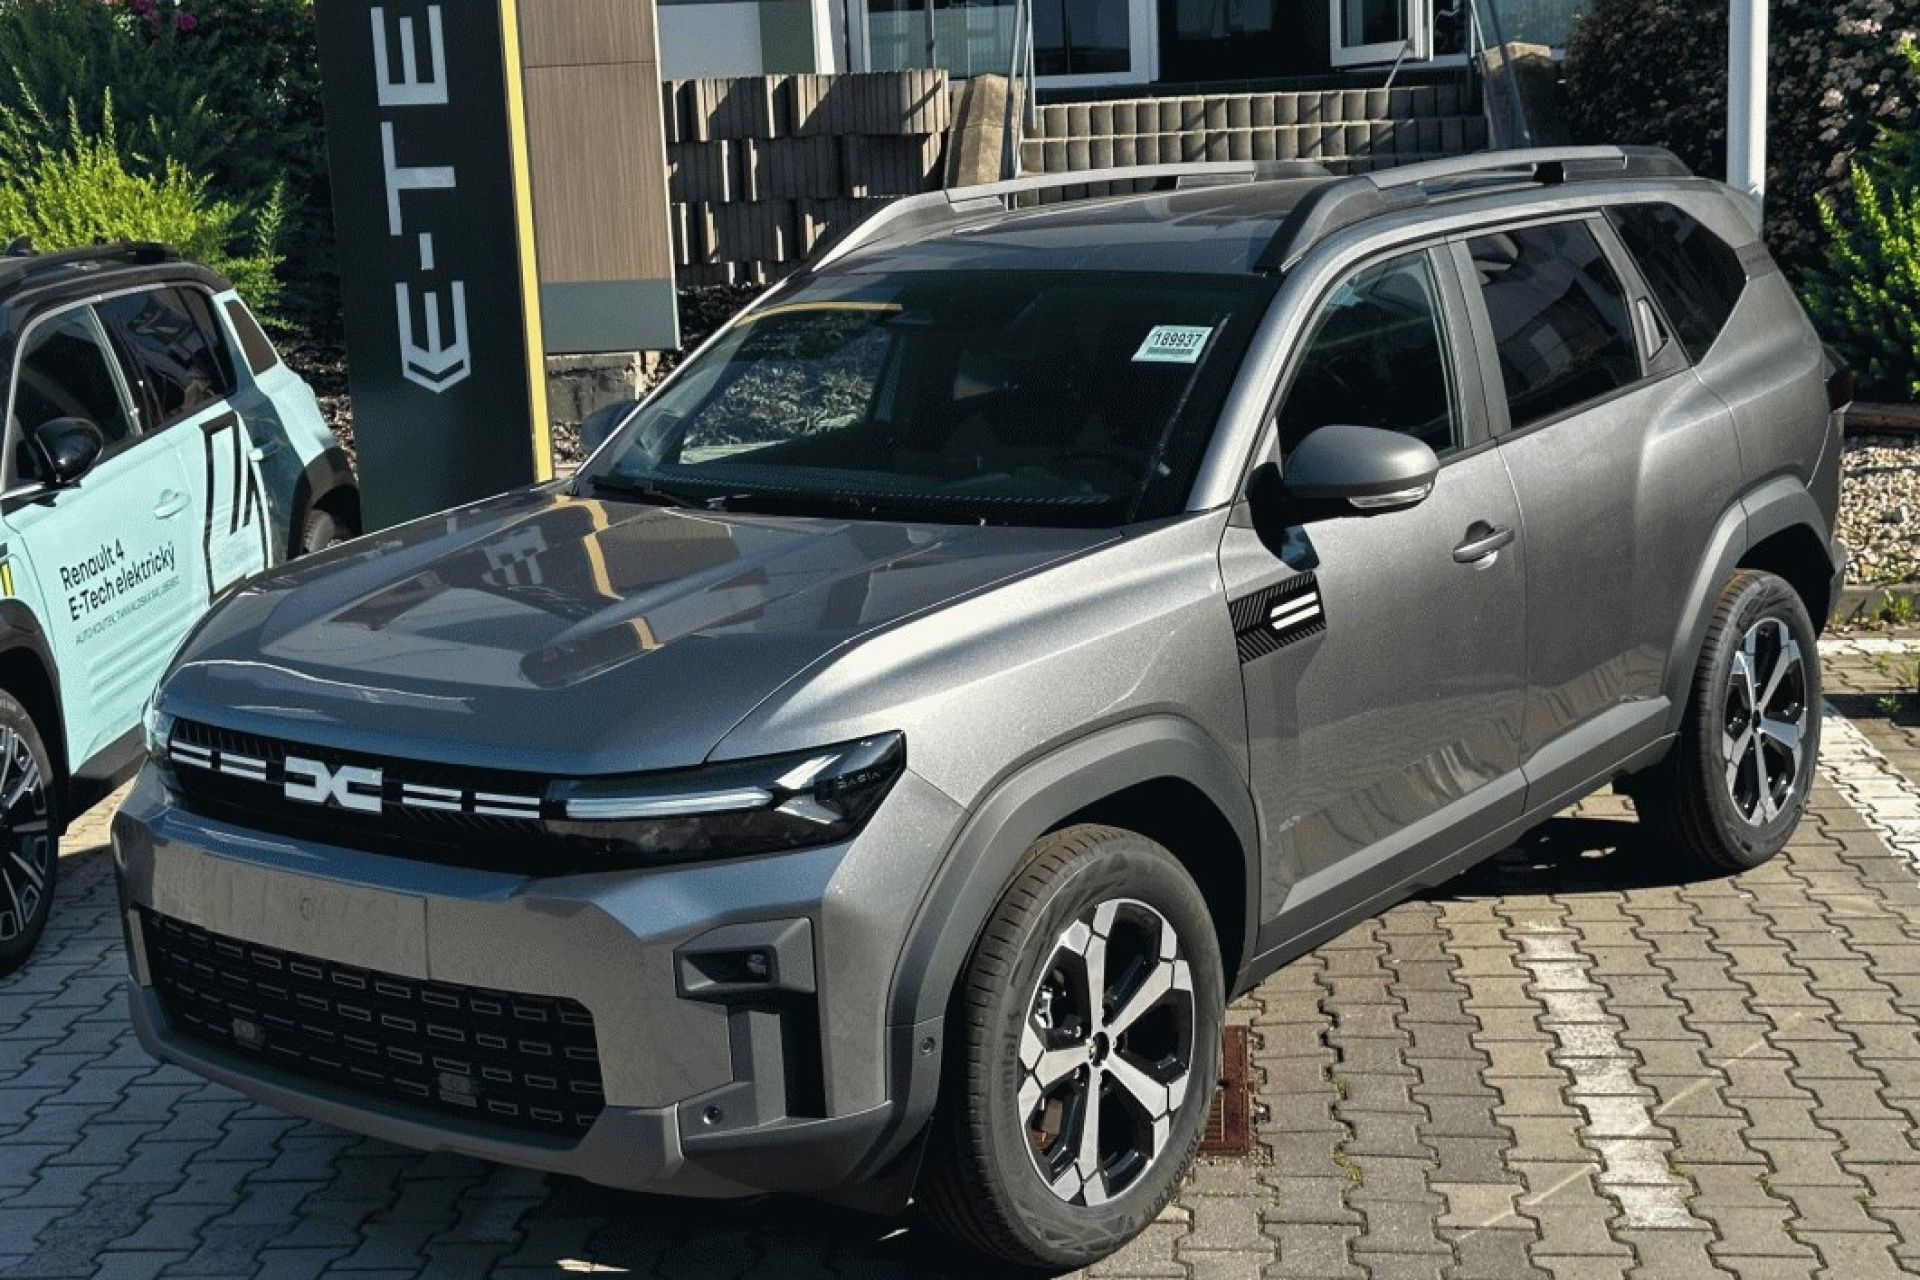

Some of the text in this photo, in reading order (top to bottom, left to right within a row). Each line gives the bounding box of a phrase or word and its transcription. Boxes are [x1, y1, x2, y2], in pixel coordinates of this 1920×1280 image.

[60, 538, 126, 591] Renault 4
[68, 576, 116, 622] E-Tech
[115, 540, 175, 594] elektrický
